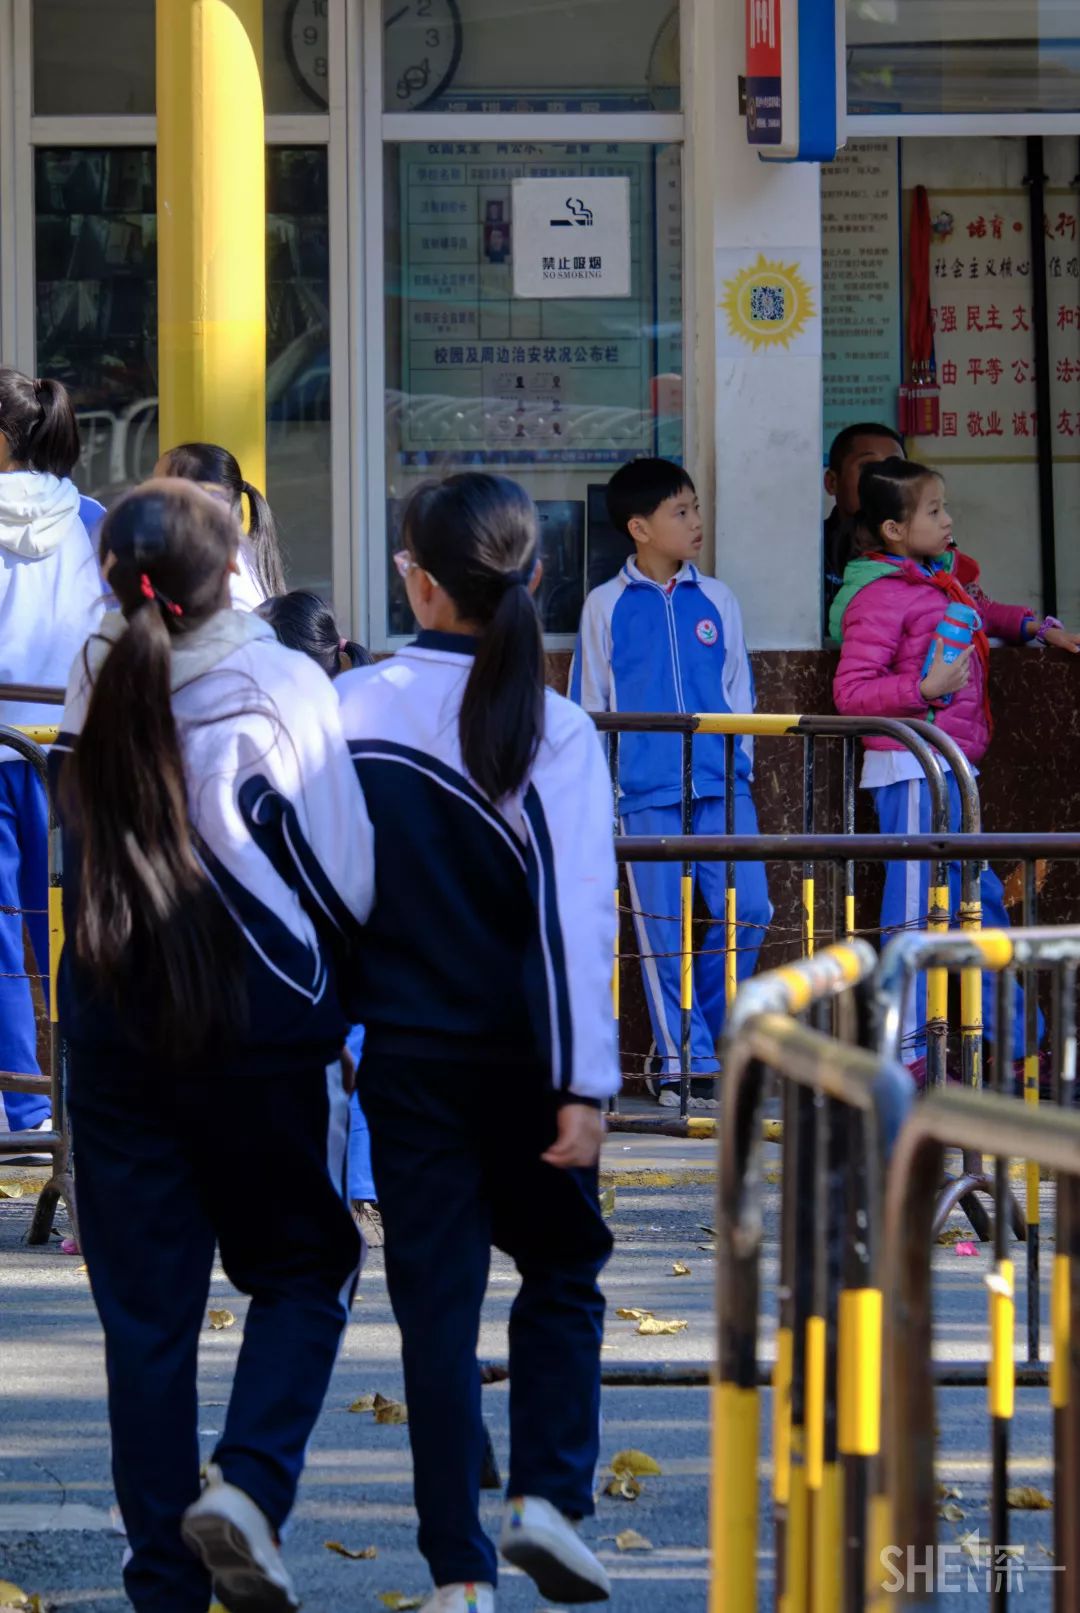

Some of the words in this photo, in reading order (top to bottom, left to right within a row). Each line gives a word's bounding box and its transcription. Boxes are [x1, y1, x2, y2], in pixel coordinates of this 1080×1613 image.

[303, 26, 318, 46] 9
[425, 28, 440, 48] 3
[313, 57, 328, 77] 8
[966, 216, 1006, 240] 培育
[542, 256, 602, 270] 禁止吸烟
[935, 257, 1080, 280] 社会主义核心值观
[543, 272, 556, 280] NO
[557, 272, 602, 280] SMOKING
[967, 305, 1004, 333] 民主
[1011, 305, 1035, 332] 文
[434, 345, 619, 365] 校园及周边治安状况公布栏
[967, 358, 1004, 385] 平等
[967, 411, 1004, 438] 敬业
